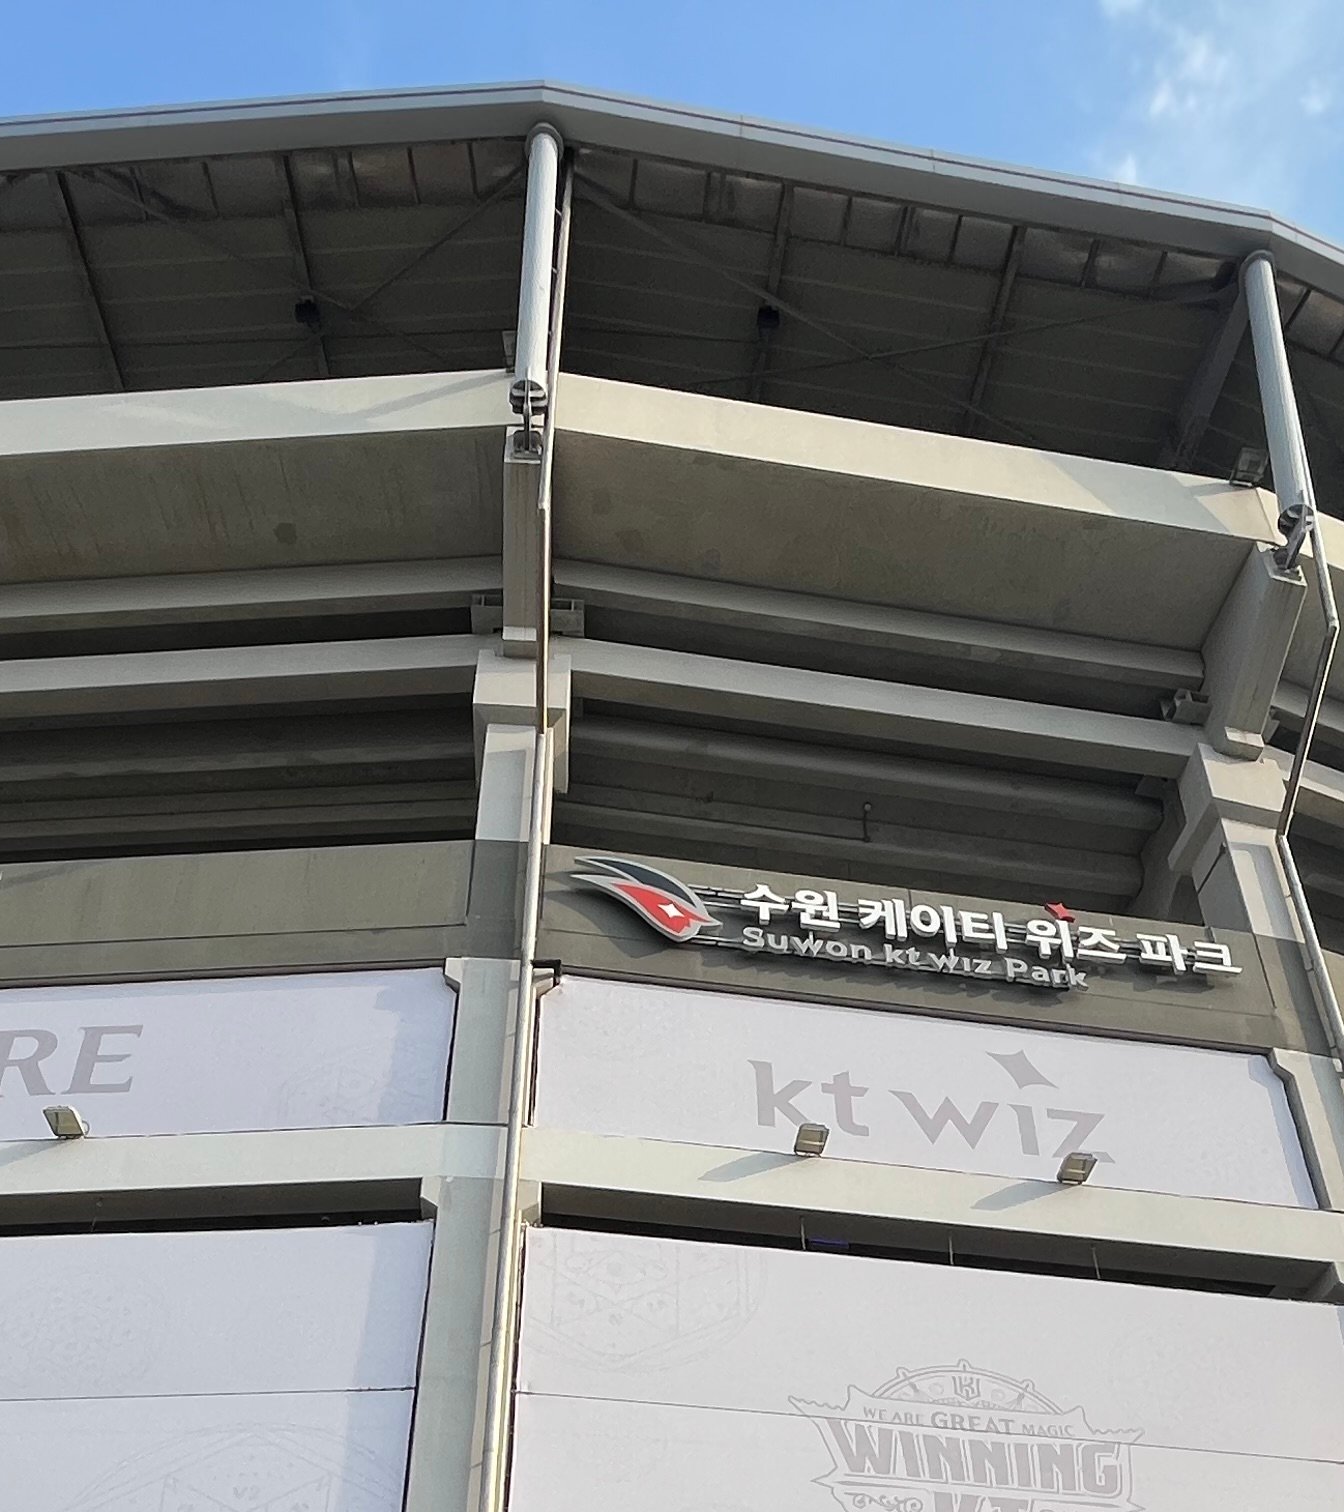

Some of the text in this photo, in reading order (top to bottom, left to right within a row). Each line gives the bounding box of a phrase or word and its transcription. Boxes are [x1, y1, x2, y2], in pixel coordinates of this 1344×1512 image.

[740, 882, 1243, 975] 수원 케이티 위즈 파크
[741, 926, 1089, 988] Suwon kt wiz Park
[747, 1050, 1114, 1164] kt wiz
[826, 1418, 1125, 1496] WINNING
[862, 1406, 1074, 1438] WE ARE GREAT MAGIC
